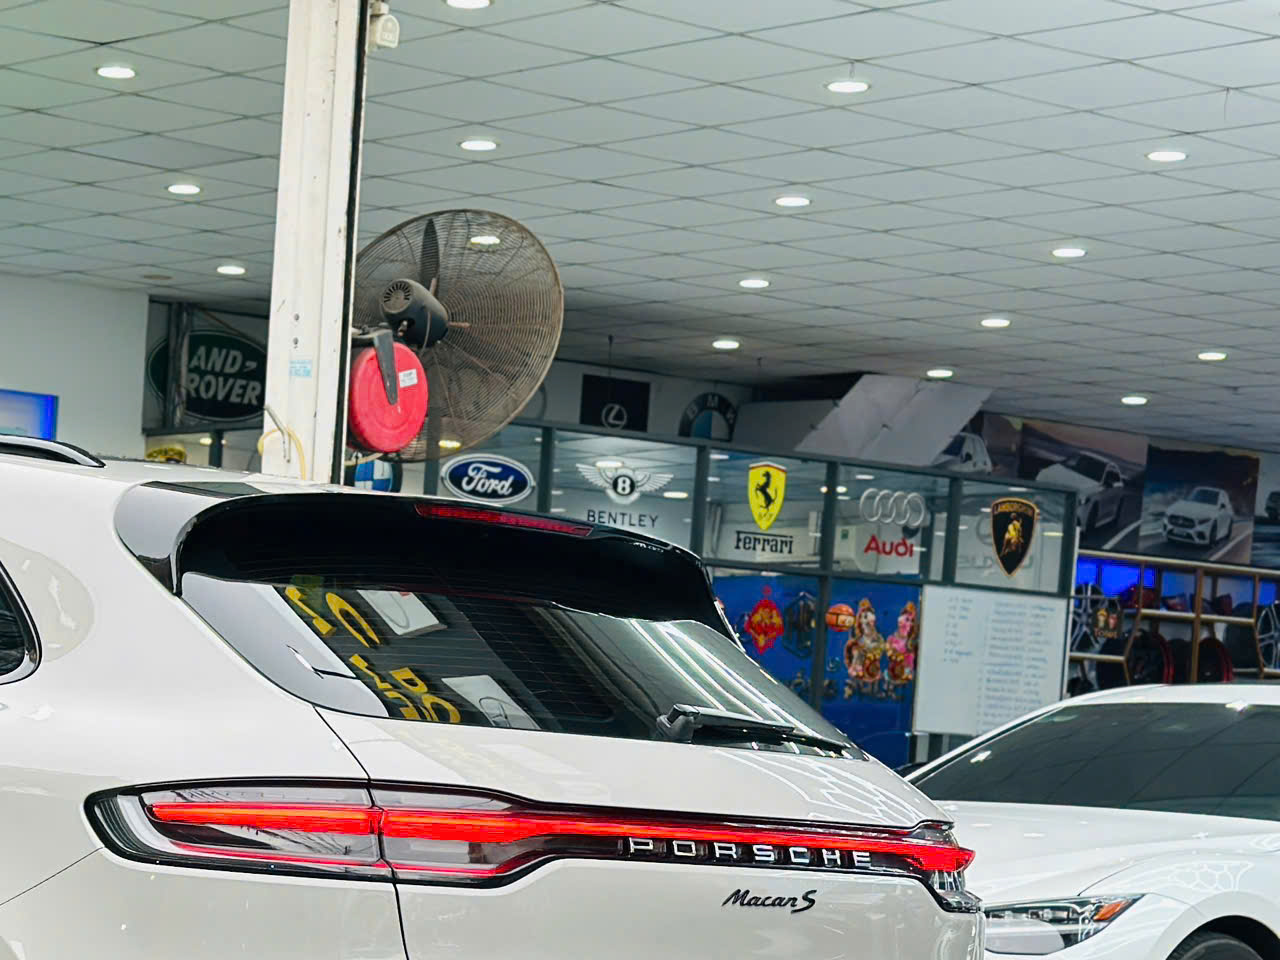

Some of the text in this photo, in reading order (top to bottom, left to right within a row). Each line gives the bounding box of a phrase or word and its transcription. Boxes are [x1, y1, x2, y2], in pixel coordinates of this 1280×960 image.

[189, 345, 244, 374] AND
[186, 372, 263, 405] ROVER
[461, 463, 516, 496] Ford
[587, 508, 659, 528] BENTLEY
[734, 530, 794, 555] Ferrari
[864, 534, 915, 558] Audi
[628, 837, 872, 867] PORSCHE
[722, 888, 818, 914] Macan S
